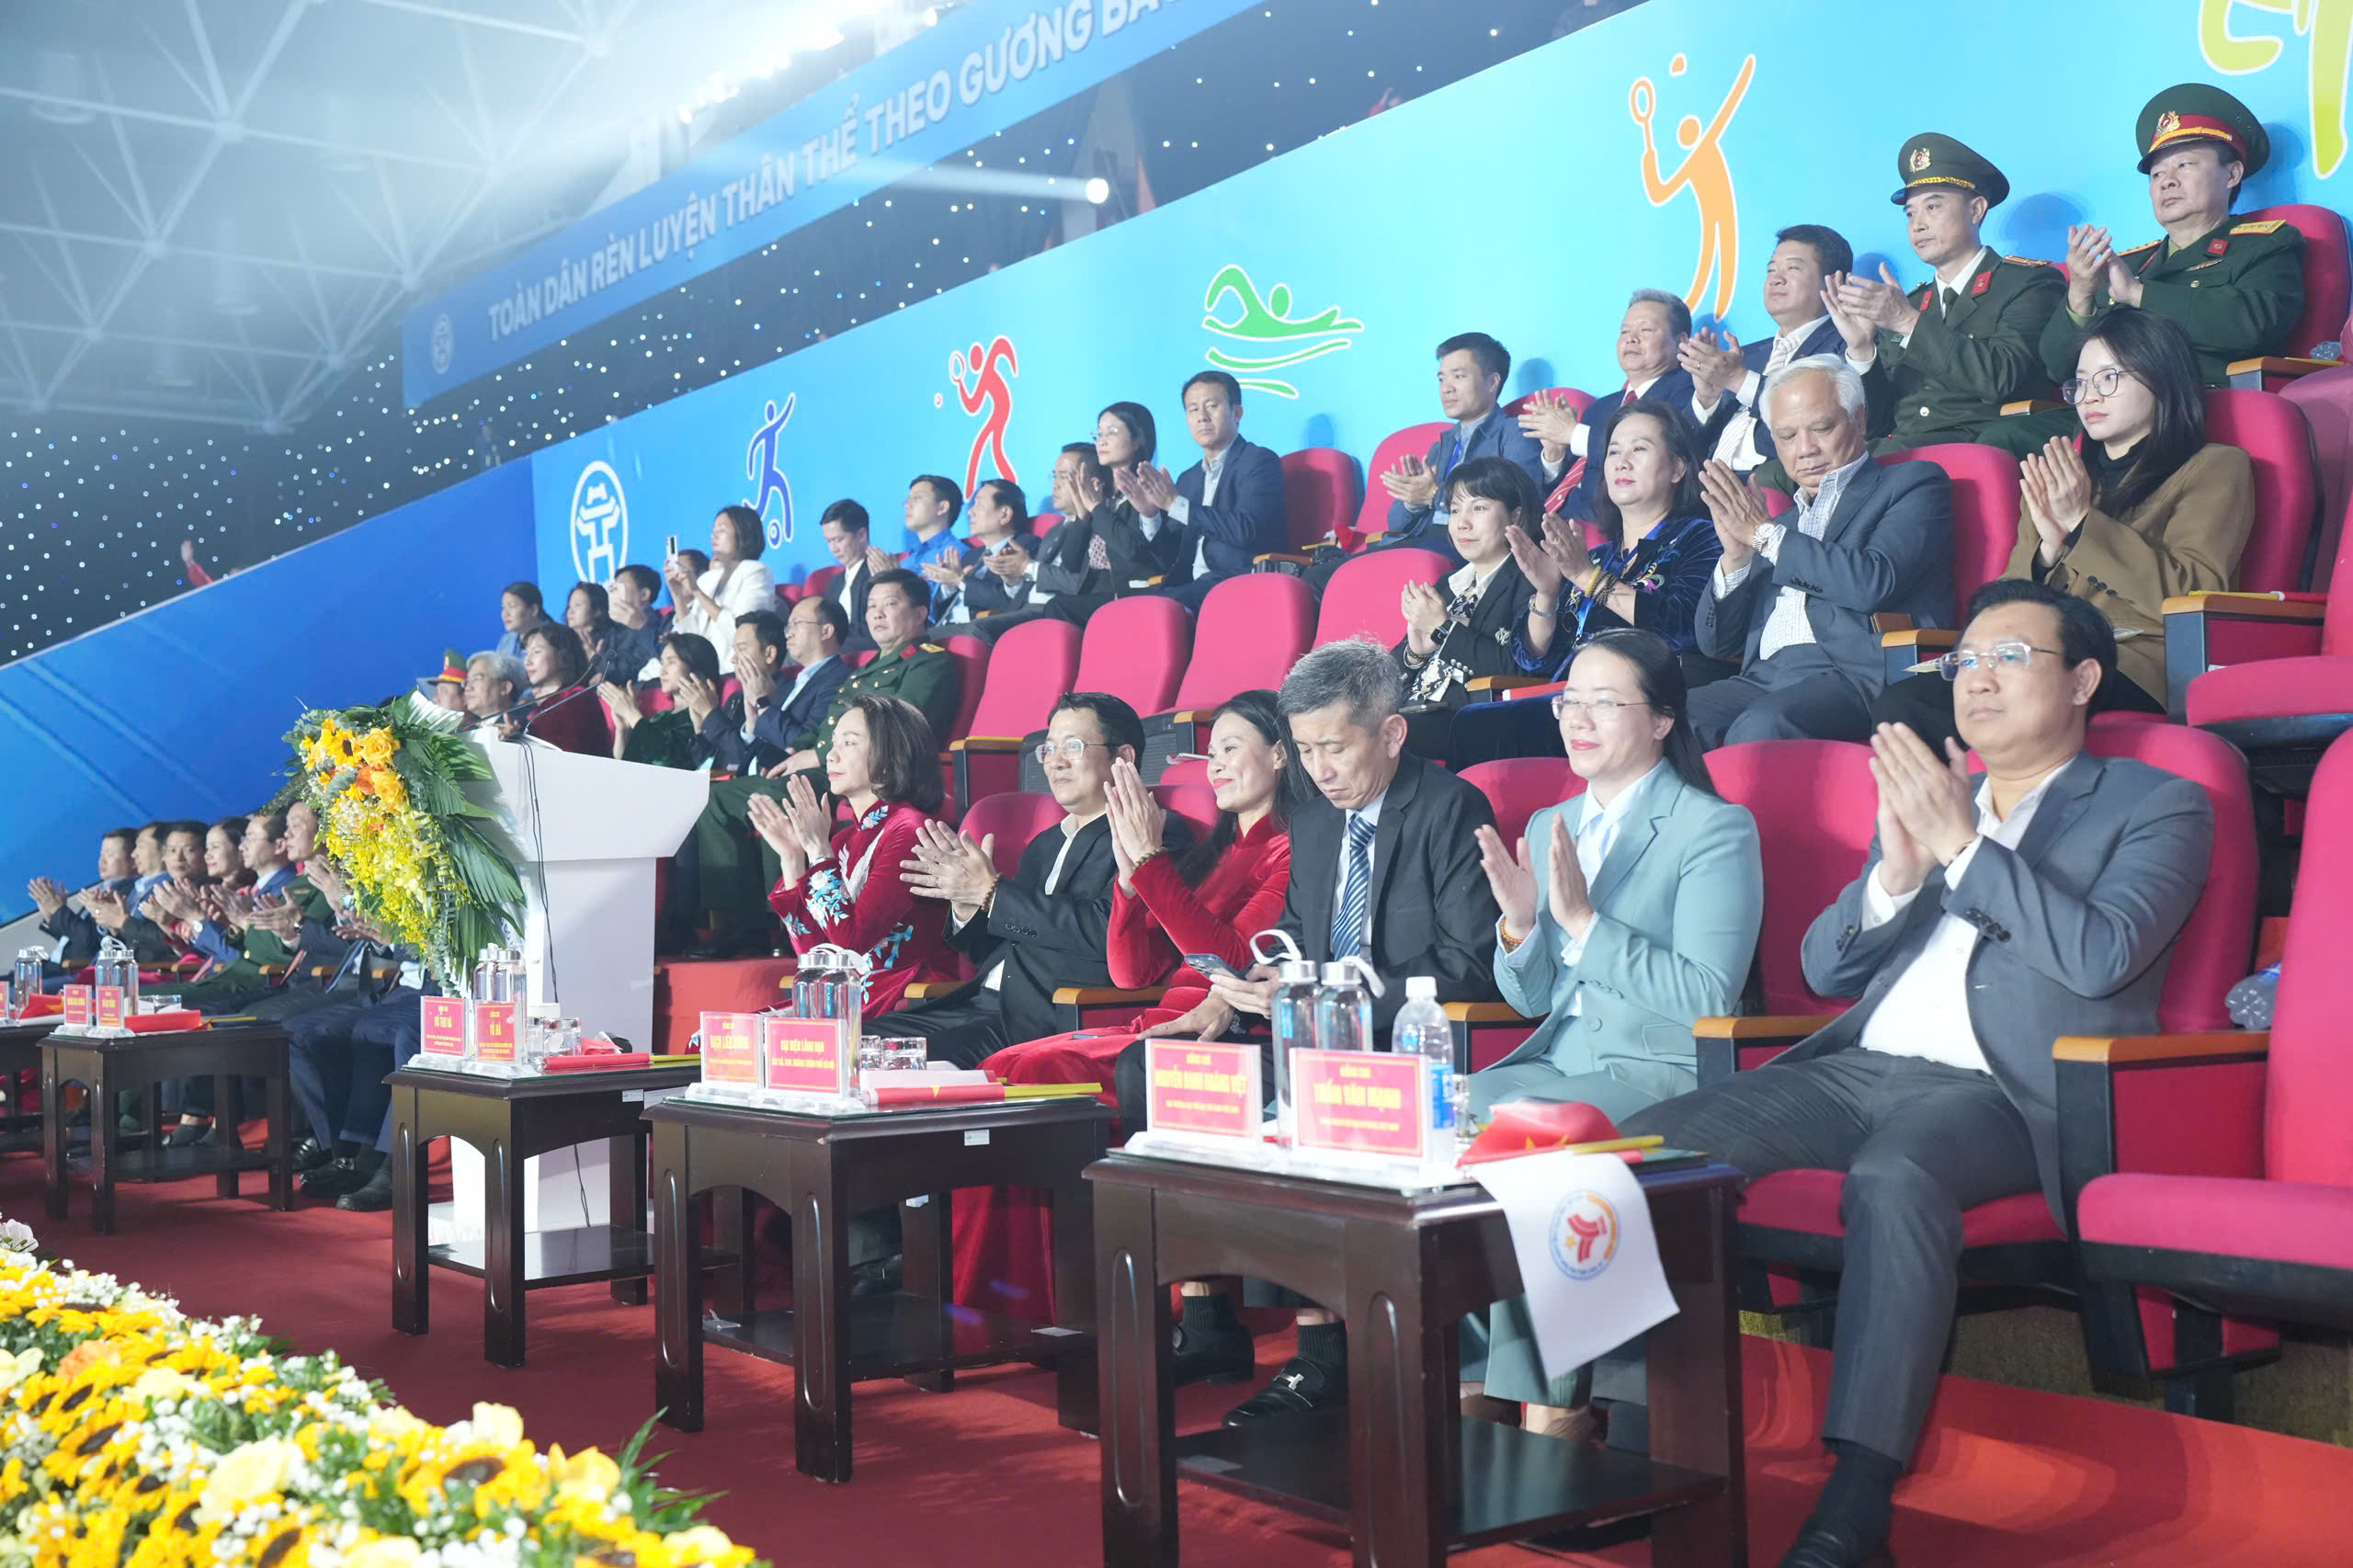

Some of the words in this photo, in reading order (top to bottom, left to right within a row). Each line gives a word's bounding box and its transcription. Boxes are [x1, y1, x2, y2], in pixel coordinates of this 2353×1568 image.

[487, 279, 541, 341] TOÀN
[544, 257, 586, 315] DÂN
[591, 232, 634, 292] RÈN
[639, 192, 717, 269] LUYỆN
[722, 152, 795, 228] THÂN
[801, 91, 861, 189] THỂ
[865, 70, 951, 155] THEO
[959, 0, 1094, 107] GƯƠNG
